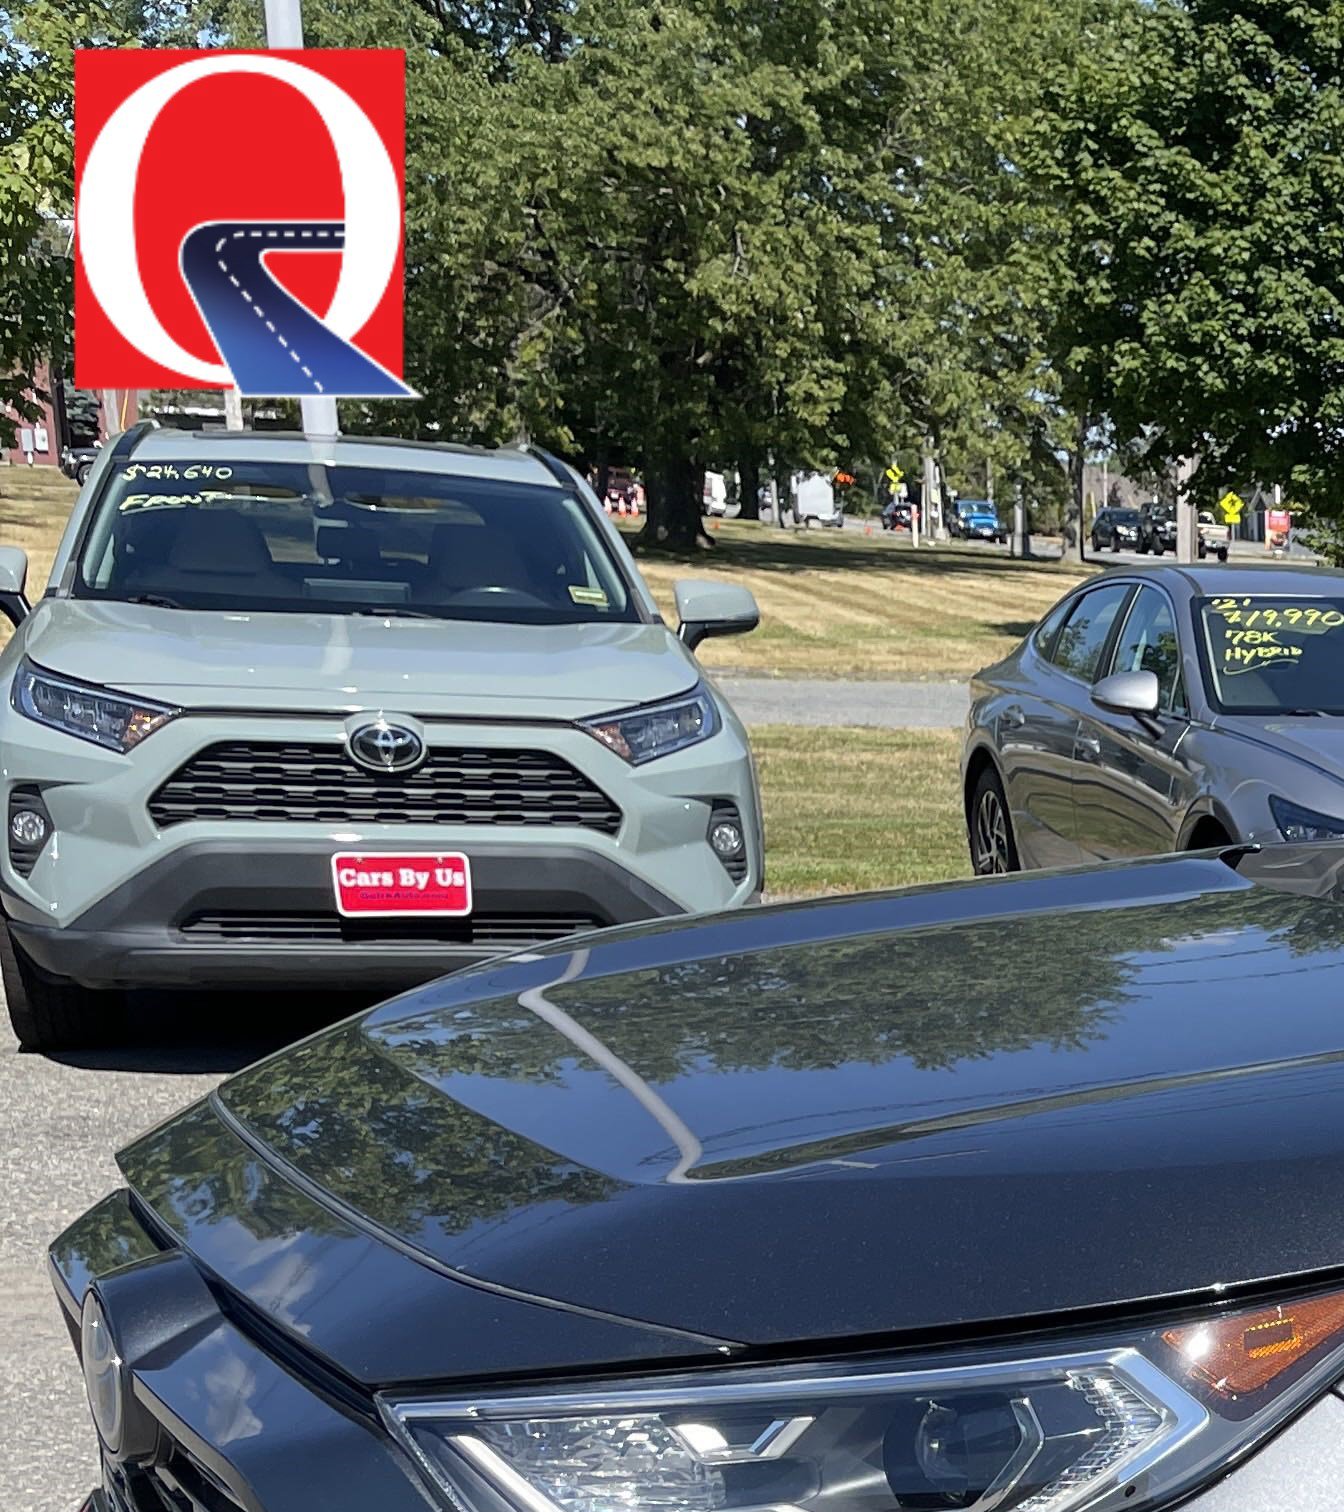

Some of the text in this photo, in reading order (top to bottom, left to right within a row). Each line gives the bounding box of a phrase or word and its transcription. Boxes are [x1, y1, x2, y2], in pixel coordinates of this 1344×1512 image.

[339, 868, 465, 890] Cars By Us
